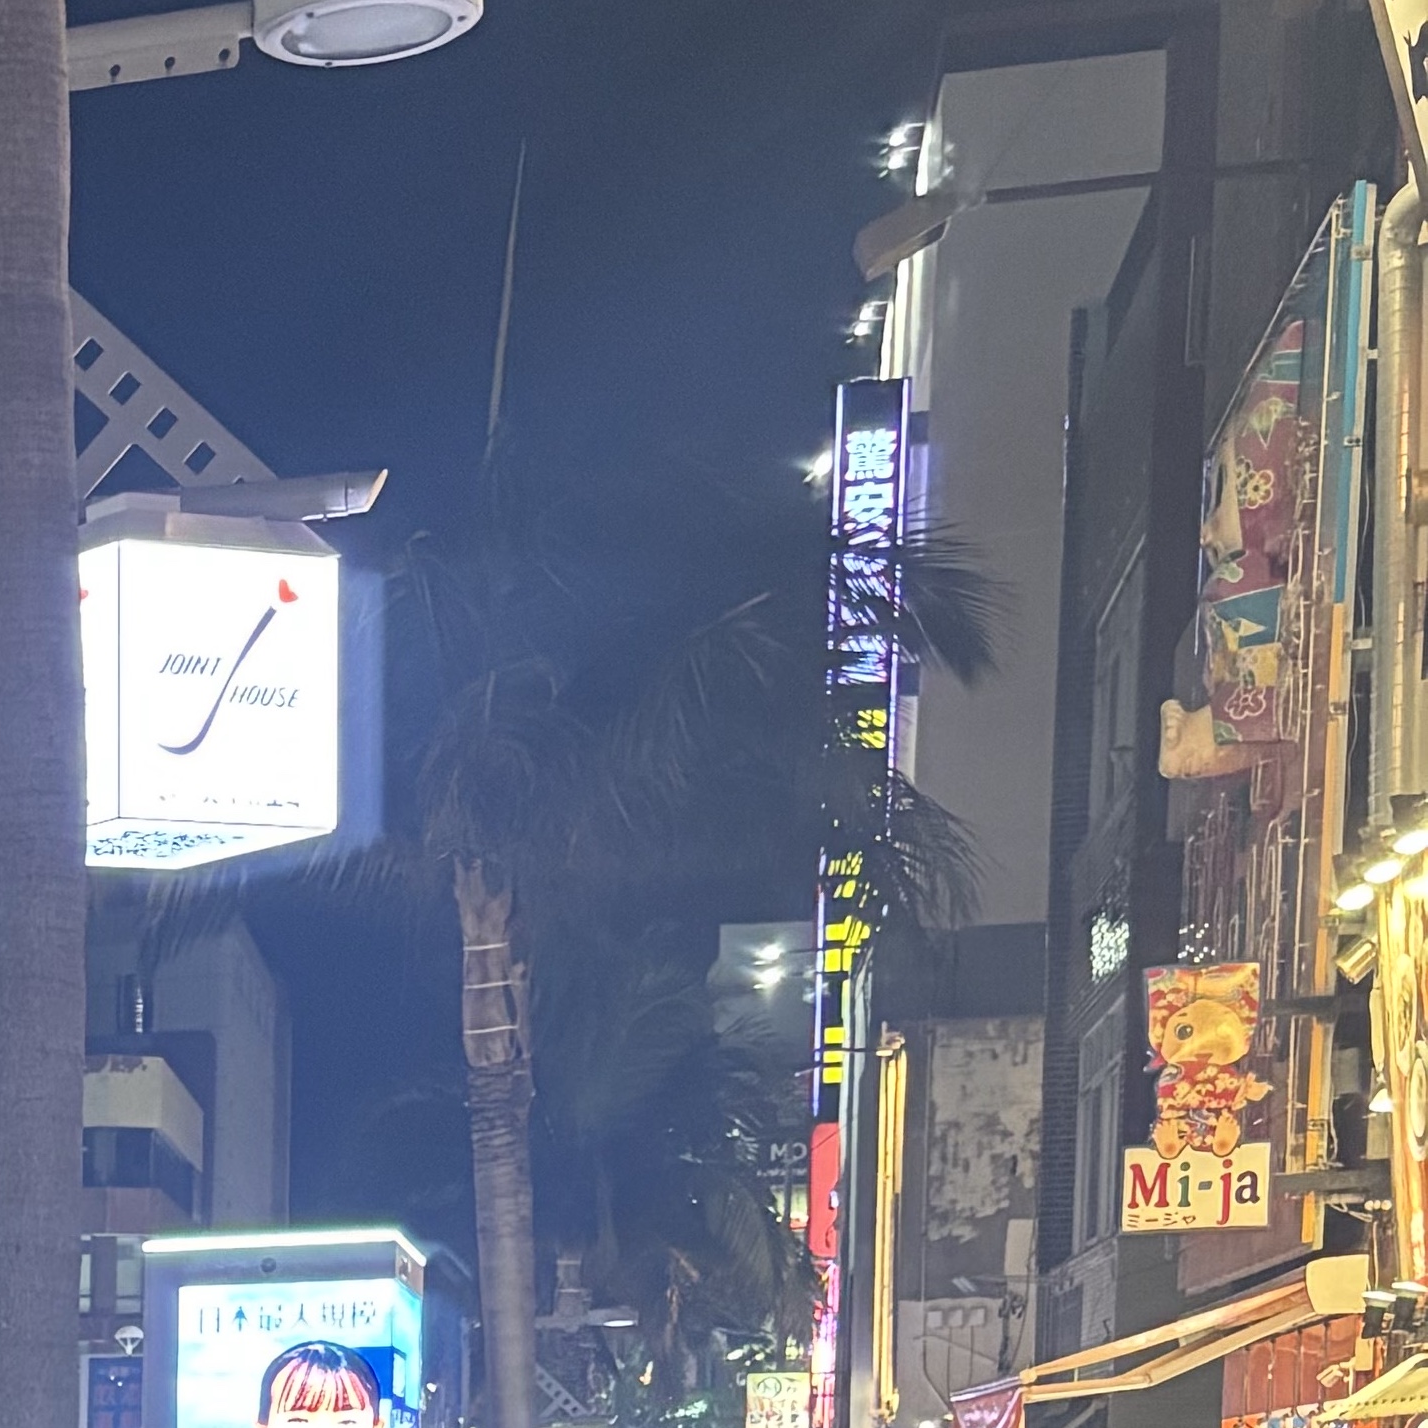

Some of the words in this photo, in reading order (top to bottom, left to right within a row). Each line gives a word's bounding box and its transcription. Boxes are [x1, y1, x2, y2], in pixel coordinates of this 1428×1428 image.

[159, 653, 222, 676] JOINT
[229, 685, 300, 708] HOUSE
[1127, 1158, 1261, 1225] Mi-ja
[1126, 1211, 1196, 1228] ミージャ
